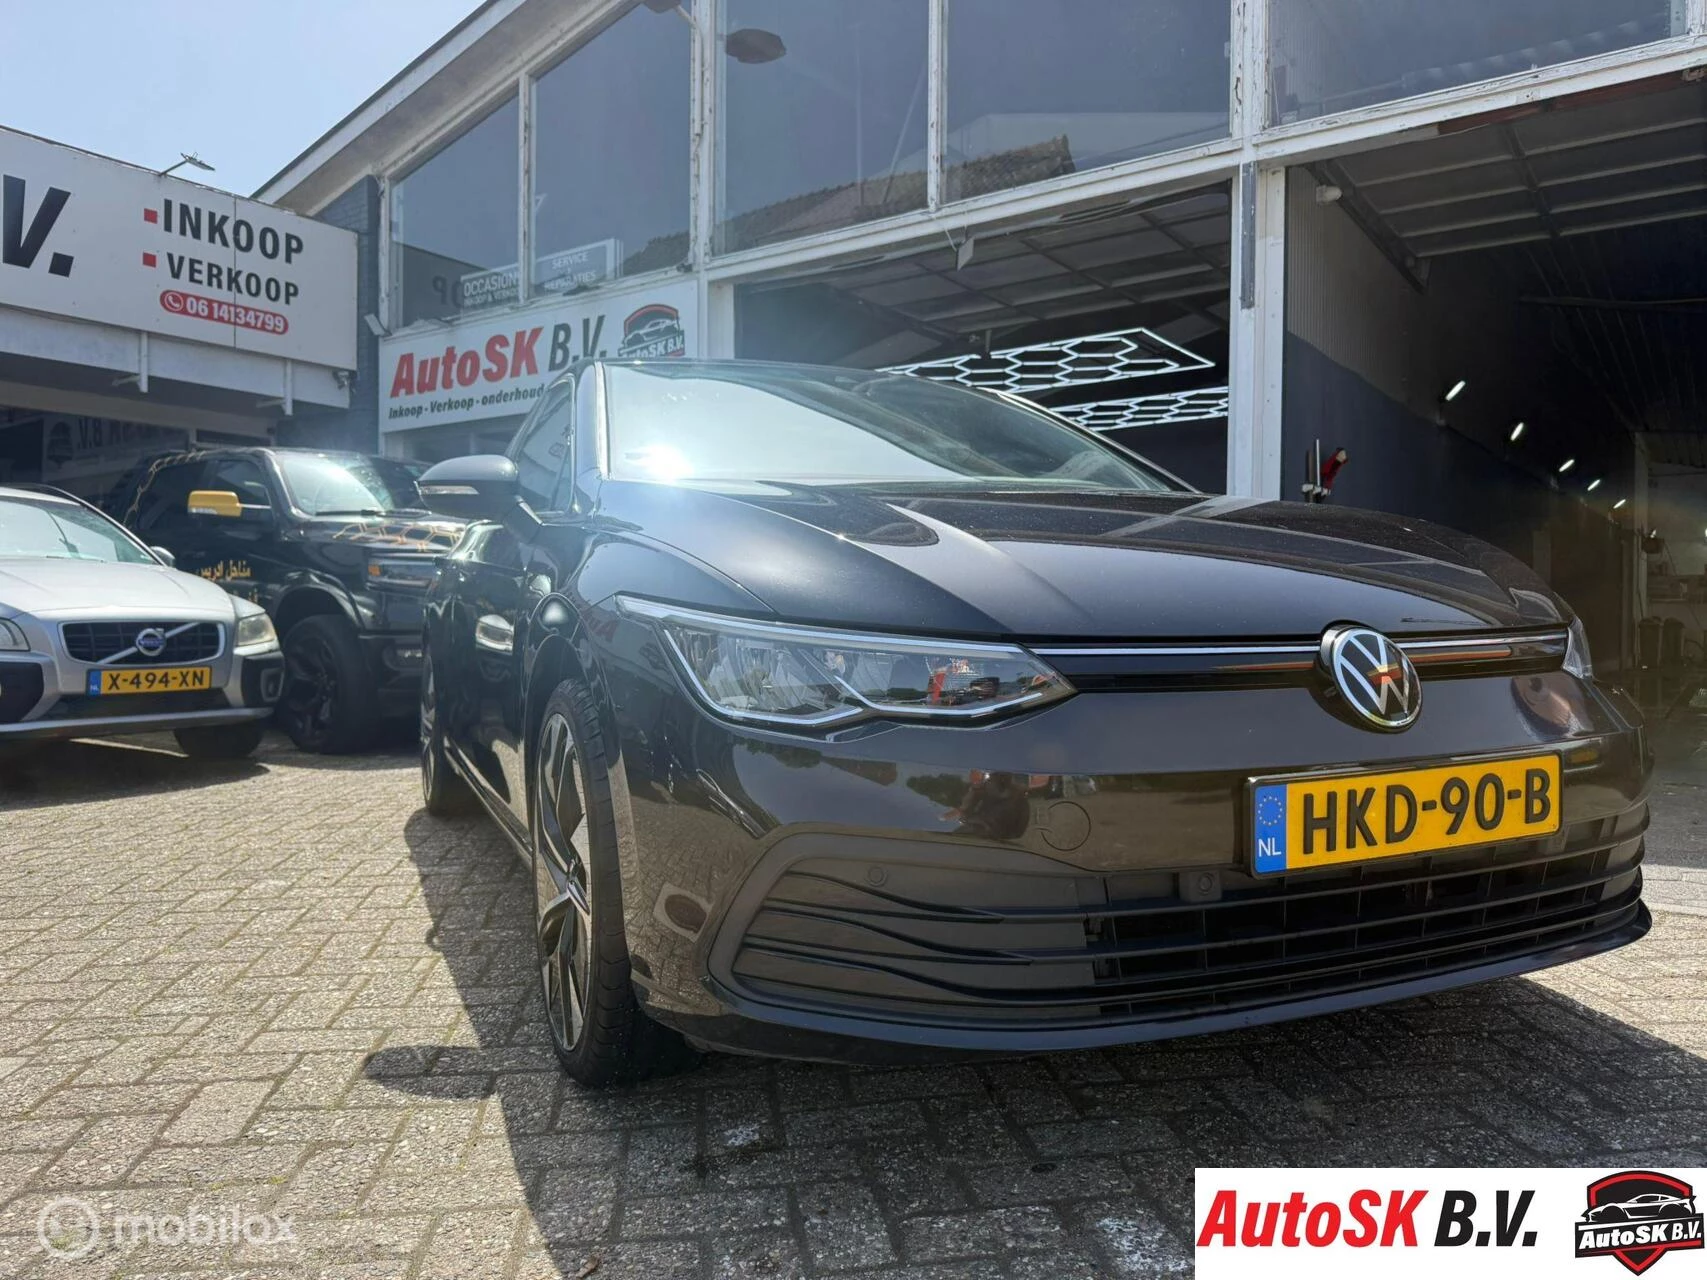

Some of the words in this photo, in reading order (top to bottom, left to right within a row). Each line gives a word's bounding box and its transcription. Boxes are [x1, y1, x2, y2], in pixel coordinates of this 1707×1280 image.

[163, 198, 304, 265] INKOOP
[166, 251, 299, 306] VERKOOP
[551, 252, 589, 269] SERVICE
[186, 297, 208, 316] 06
[212, 302, 285, 332] 14134799
[390, 326, 544, 398] AutoSK
[549, 314, 607, 372] B.V.
[388, 402, 423, 420] Inkoop
[429, 396, 474, 415] Verkoop
[481, 383, 545, 406] onderhoud
[107, 669, 204, 691] X-494-XN
[1257, 837, 1282, 858] NL
[1302, 768, 1552, 855] HKD-90-B
